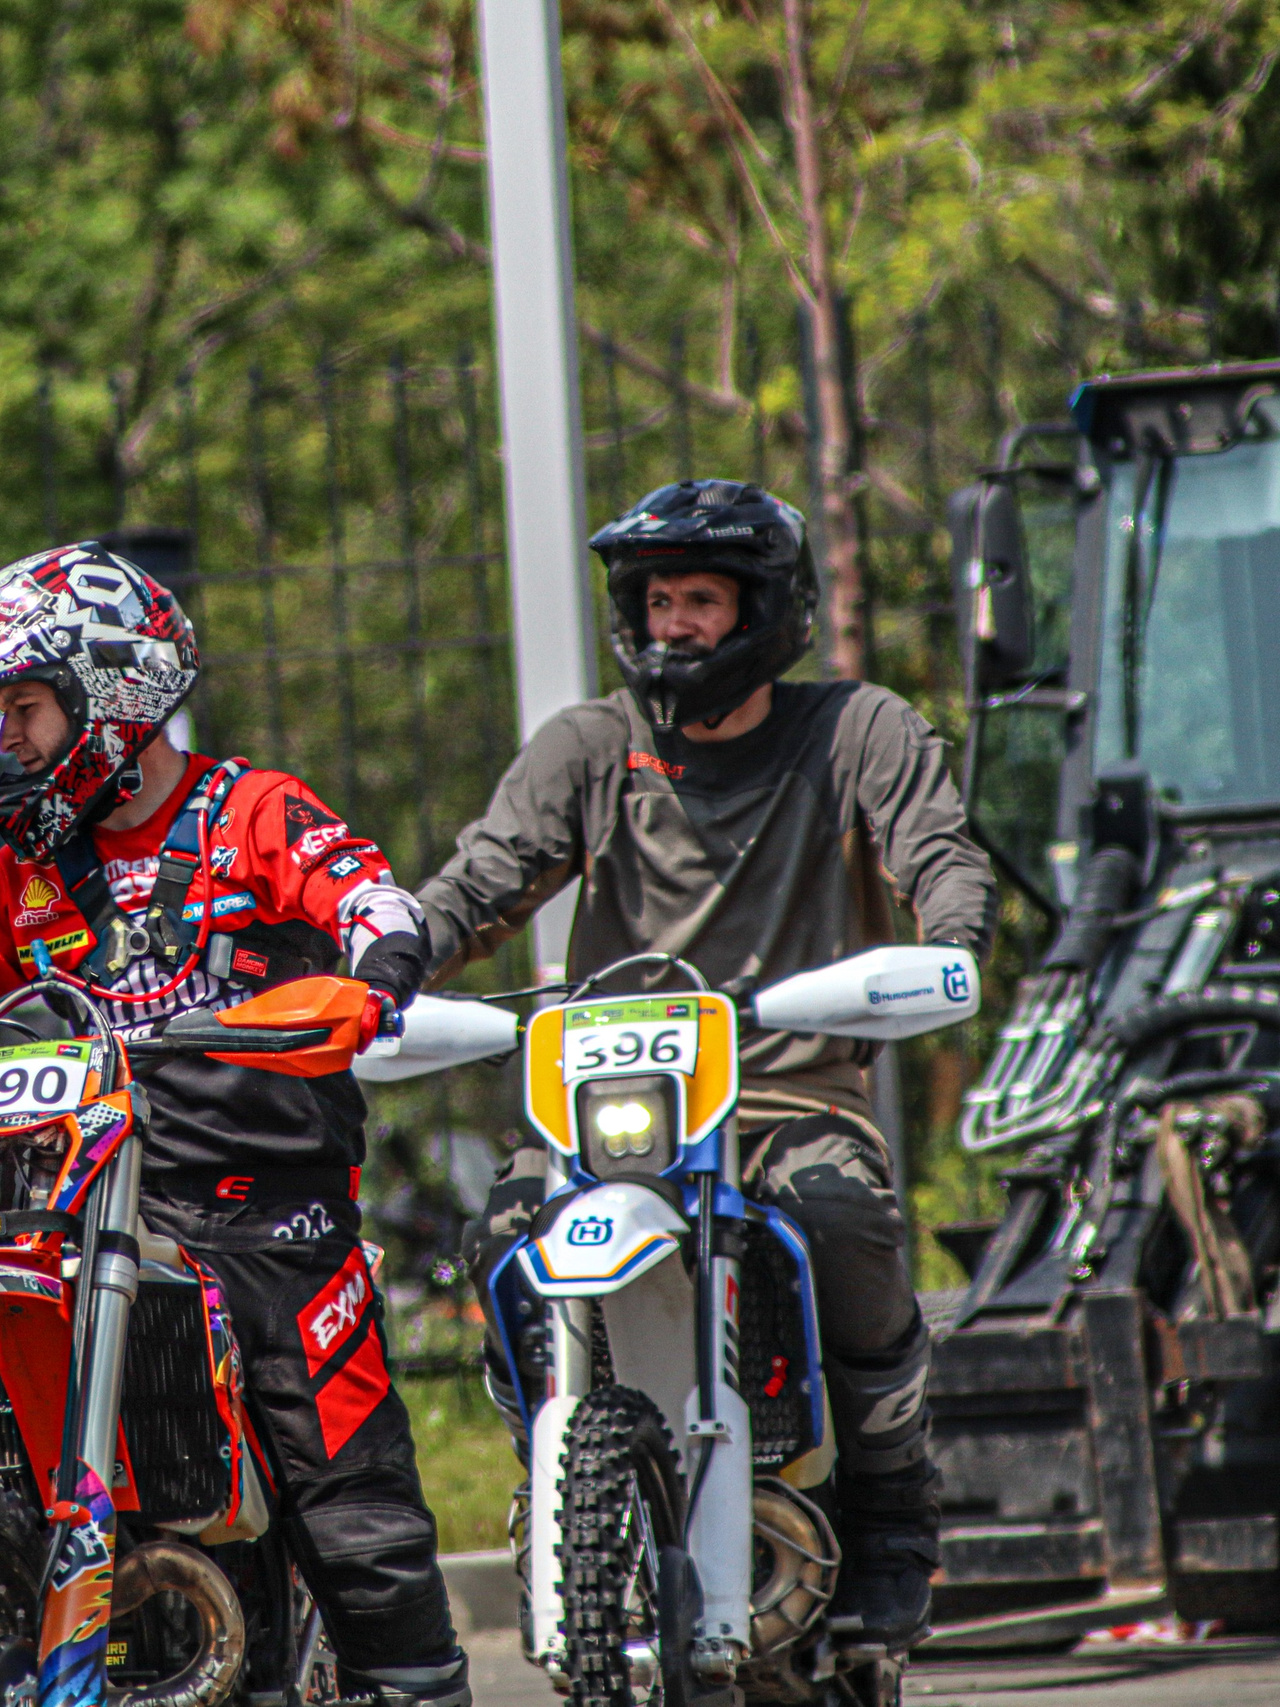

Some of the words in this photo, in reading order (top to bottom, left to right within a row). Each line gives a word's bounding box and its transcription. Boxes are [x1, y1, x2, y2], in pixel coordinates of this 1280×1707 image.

[192, 894, 253, 918] MTOREX
[14, 912, 60, 928] Shell
[576, 1029, 683, 1071] 396
